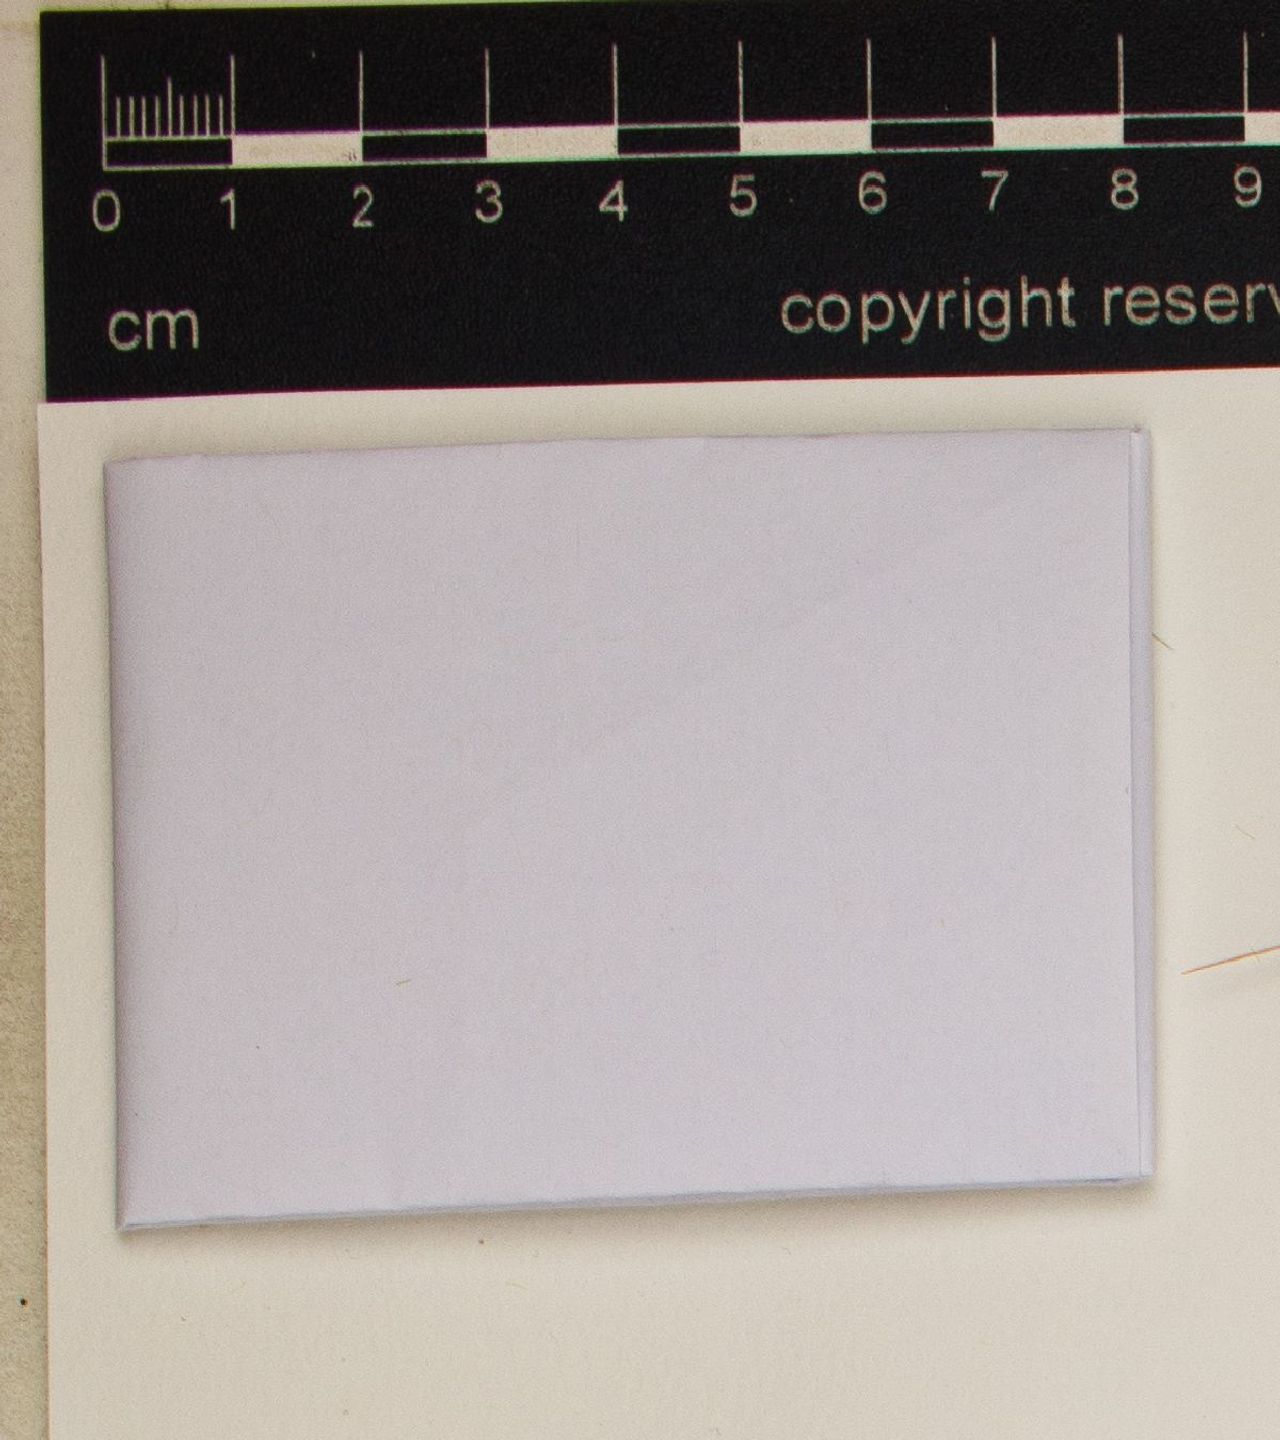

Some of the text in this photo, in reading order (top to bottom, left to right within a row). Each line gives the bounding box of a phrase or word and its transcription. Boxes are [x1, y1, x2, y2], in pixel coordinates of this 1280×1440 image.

[93, 190, 120, 231] 0
[221, 189, 235, 229] 1
[353, 185, 372, 227] 2
[476, 181, 502, 223] 3
[599, 180, 627, 221] 4
[730, 175, 756, 216] 5
[859, 172, 886, 214] 6
[982, 169, 1008, 210] 7
[1111, 168, 1138, 210] 8
[1234, 166, 1261, 207] 9
[109, 310, 198, 350] cm
[782, 276, 1075, 344] copyright
